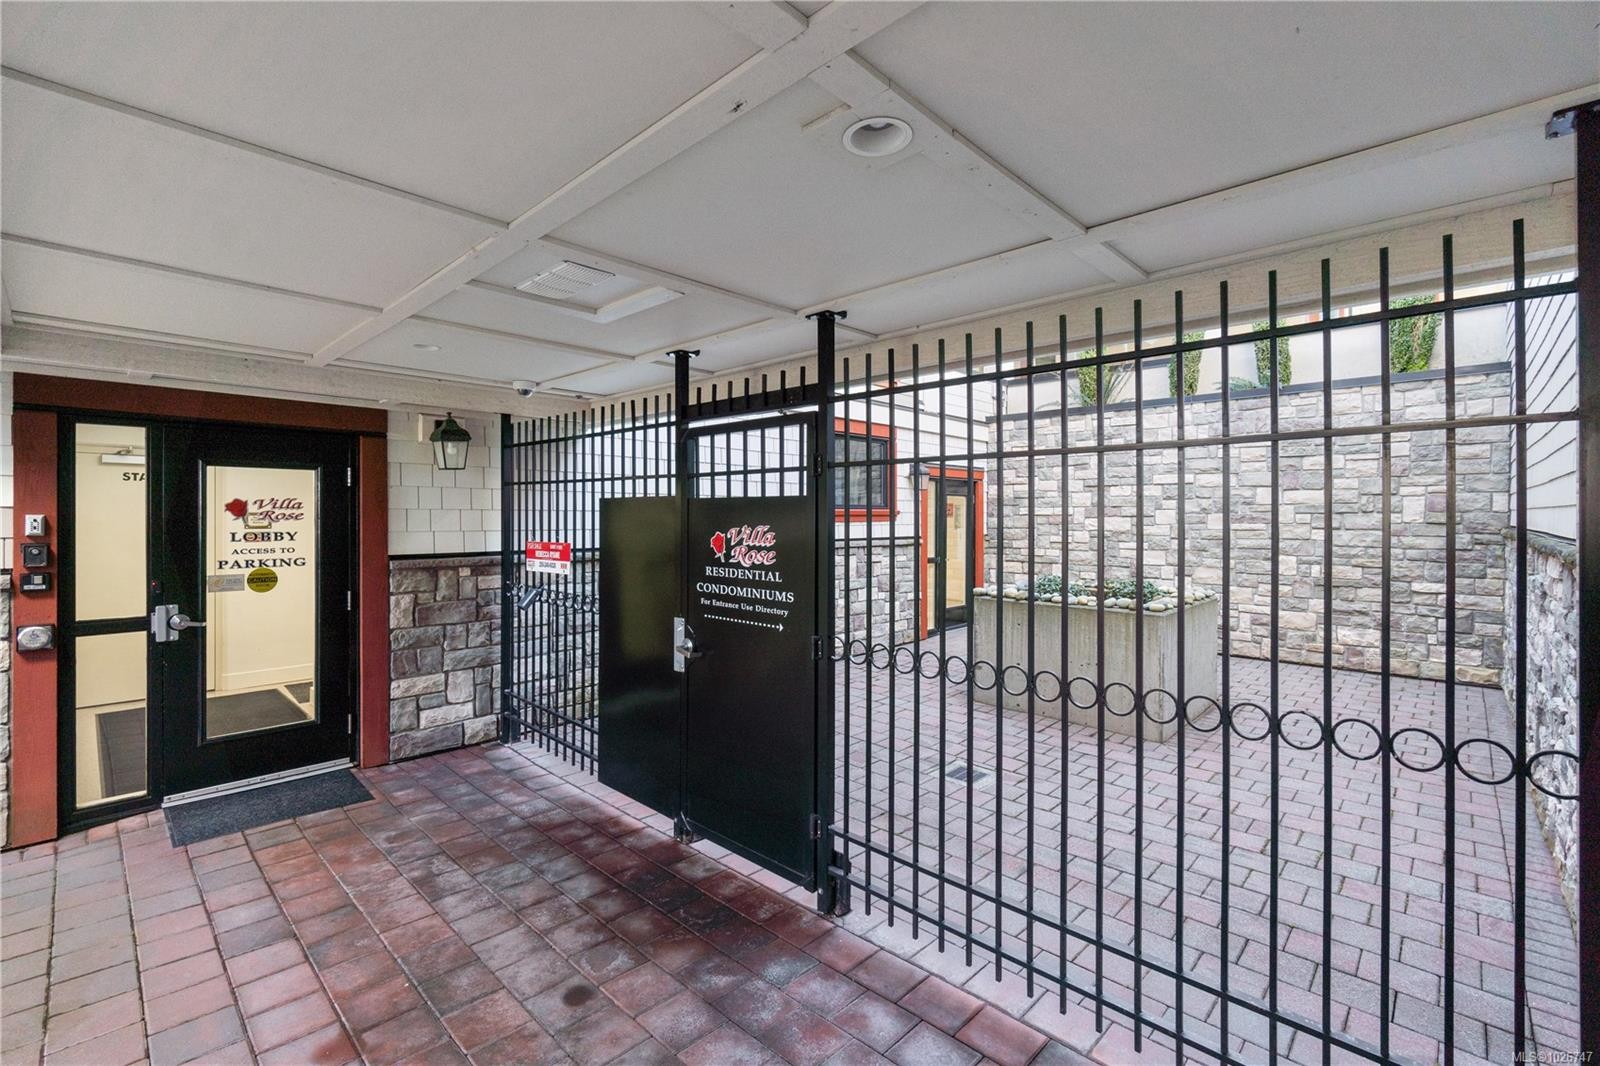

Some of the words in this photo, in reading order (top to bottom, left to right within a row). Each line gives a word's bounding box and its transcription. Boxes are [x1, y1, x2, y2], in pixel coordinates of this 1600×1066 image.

[253, 497, 304, 510] Villa
[258, 510, 304, 523] Rose
[230, 531, 298, 542] LOBBY
[727, 524, 776, 546] Villa
[217, 557, 306, 569] PARKING
[729, 545, 776, 567] Rose
[706, 566, 782, 582] RESIDENTIAL
[696, 582, 794, 602] CONDOMINIUMS
[700, 597, 711, 605] For
[712, 598, 739, 609] Entrance
[740, 602, 753, 611] Use
[755, 604, 788, 617] Directory
